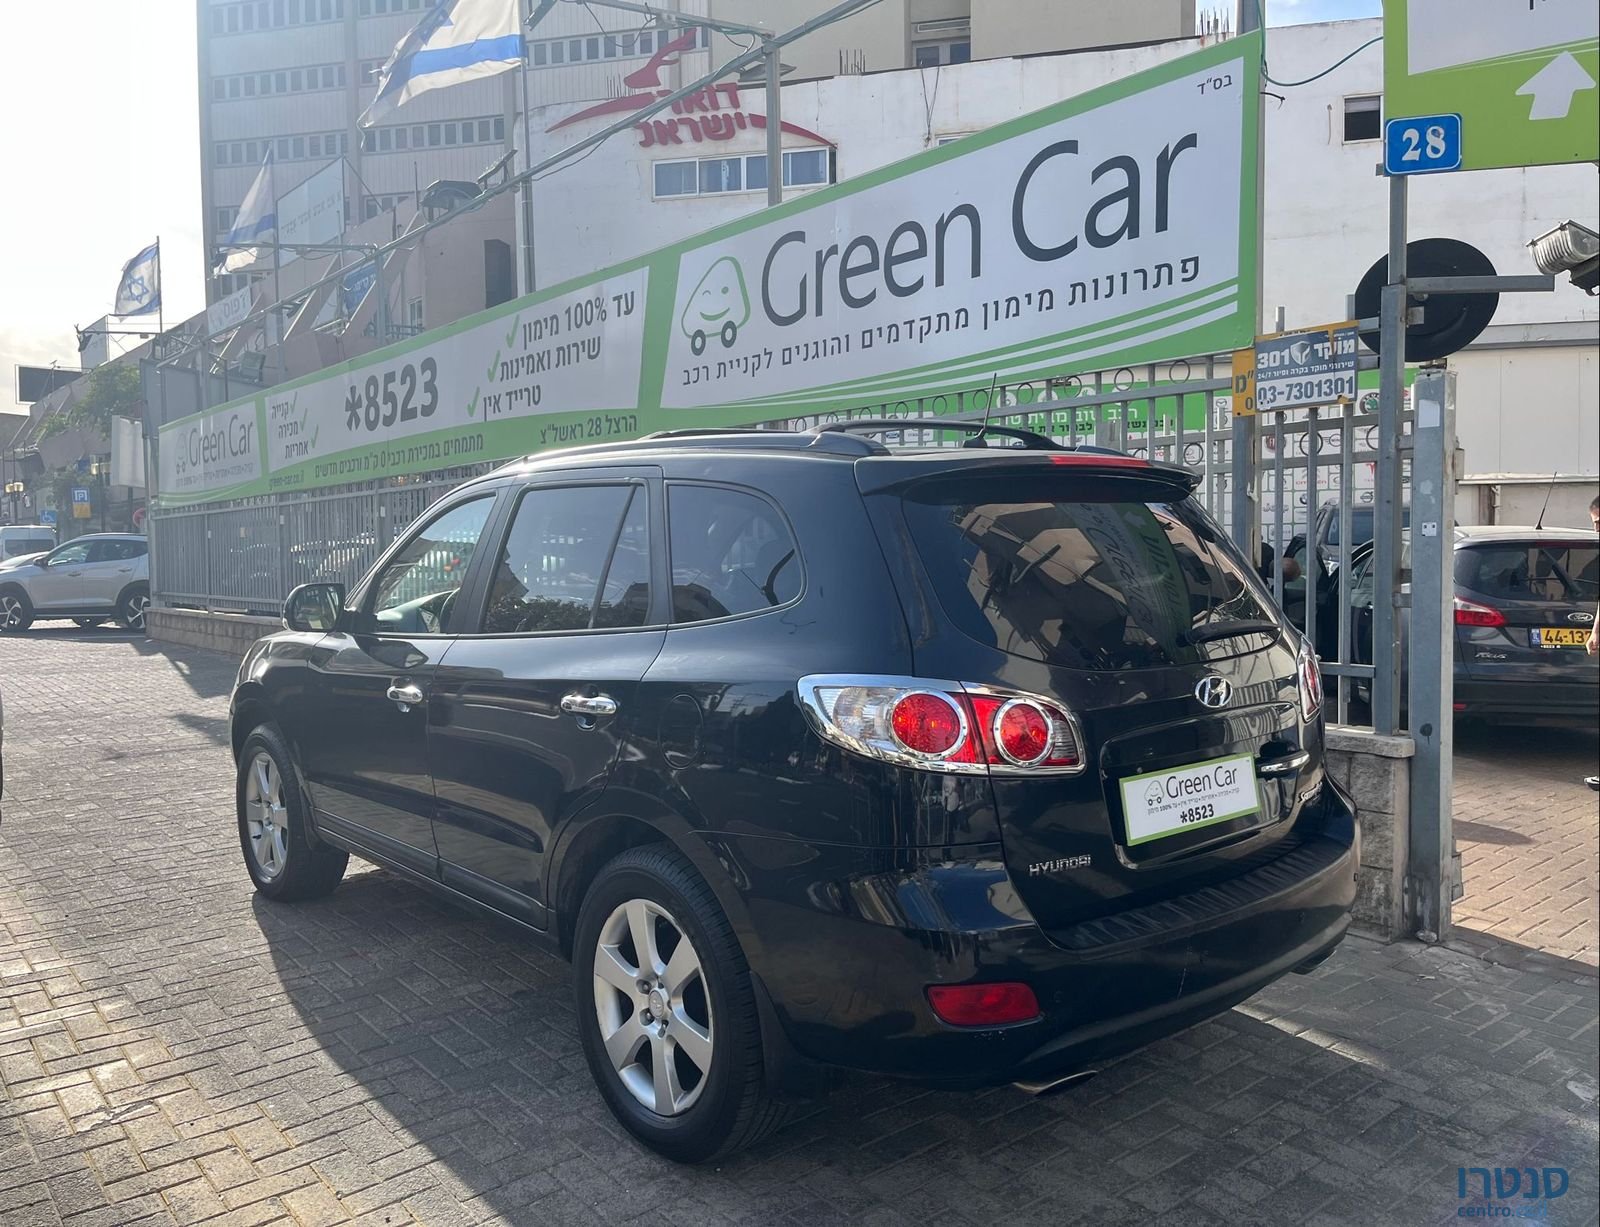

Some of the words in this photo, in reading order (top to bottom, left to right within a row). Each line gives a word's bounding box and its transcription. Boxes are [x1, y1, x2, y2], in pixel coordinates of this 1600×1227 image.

[1402, 126, 1446, 161] 28
[761, 204, 982, 327] Green
[1011, 132, 1197, 263] Car
[1068, 255, 1200, 306] פתרונות
[565, 296, 607, 332] 100%
[612, 290, 635, 318] עד
[982, 288, 1054, 330] מימון
[522, 313, 560, 350] מימון
[860, 307, 969, 349] מתקדמים
[555, 335, 601, 368] שירות
[716, 347, 773, 378] לקניית
[781, 334, 850, 366] והוגנים
[1257, 348, 1290, 369] 301
[500, 349, 551, 382] ואמינות
[683, 365, 710, 385] רכב
[505, 384, 542, 411] טרייד
[1257, 375, 1354, 404] 03-7301301
[483, 393, 502, 423] אין
[278, 421, 299, 439] מכירה
[587, 417, 602, 437] 28
[605, 414, 638, 436] הרצל
[189, 427, 226, 467] Green
[228, 414, 253, 457] Car
[285, 440, 309, 459] אחריות
[408, 441, 441, 464] במכירת
[443, 433, 484, 456] מתמחים
[1166, 774, 1212, 799] Green
[1214, 765, 1238, 788] Car
[1029, 854, 1091, 876] HYUNDAI
